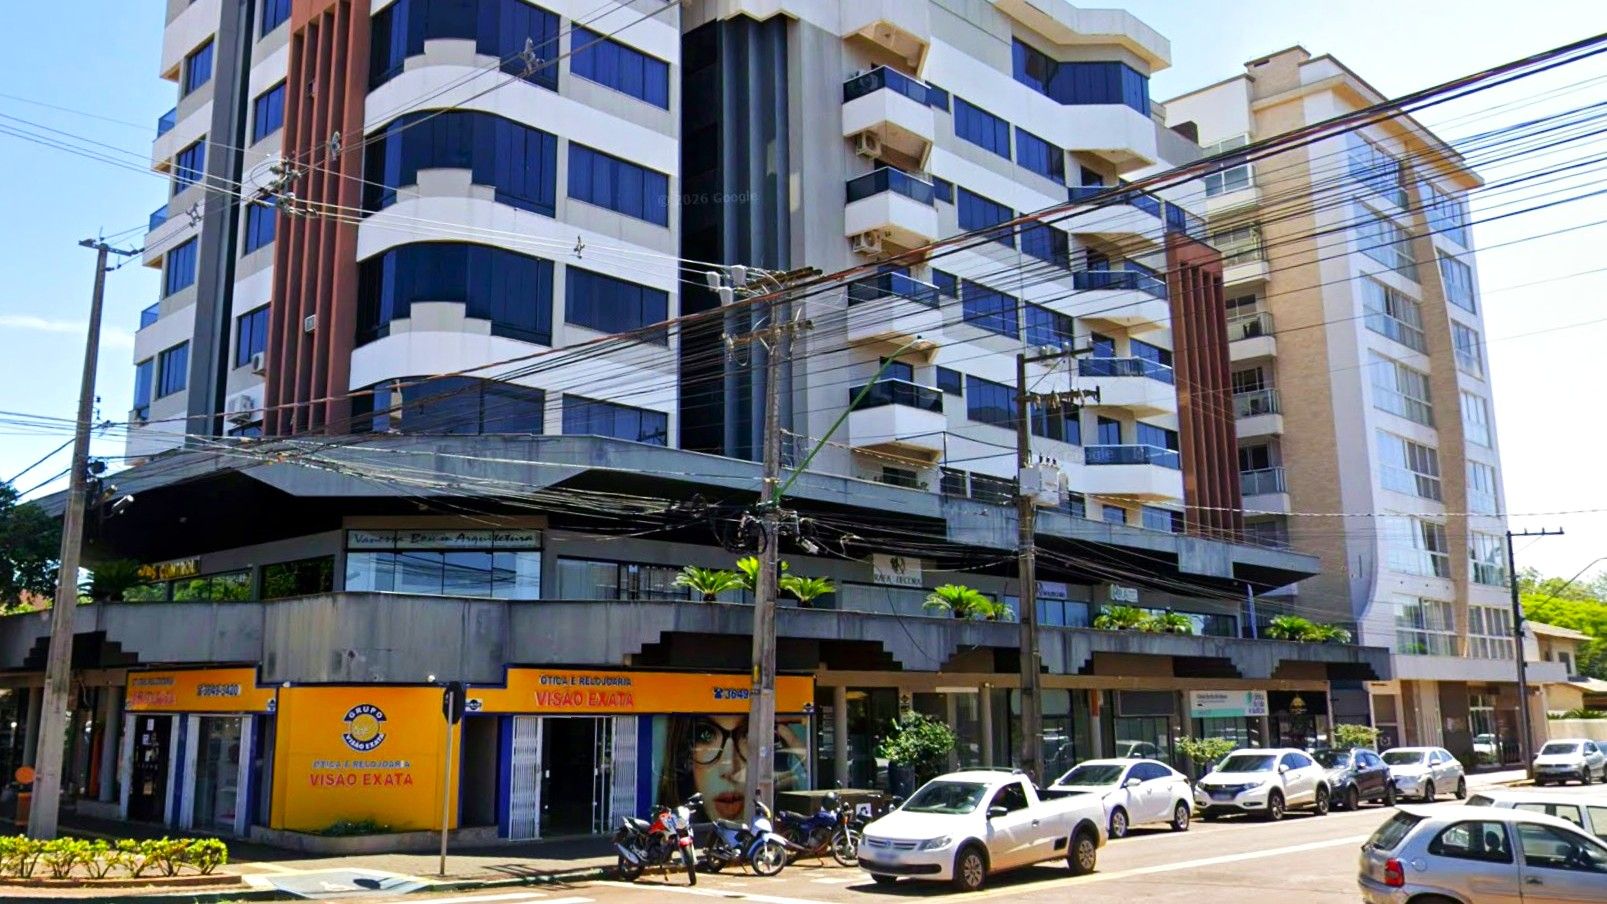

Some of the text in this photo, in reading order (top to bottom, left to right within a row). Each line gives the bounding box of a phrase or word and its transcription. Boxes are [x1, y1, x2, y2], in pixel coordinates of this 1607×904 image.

[587, 691, 634, 707] EXATA
[348, 704, 383, 719] GRUPO
[362, 773, 413, 786] EXATA
